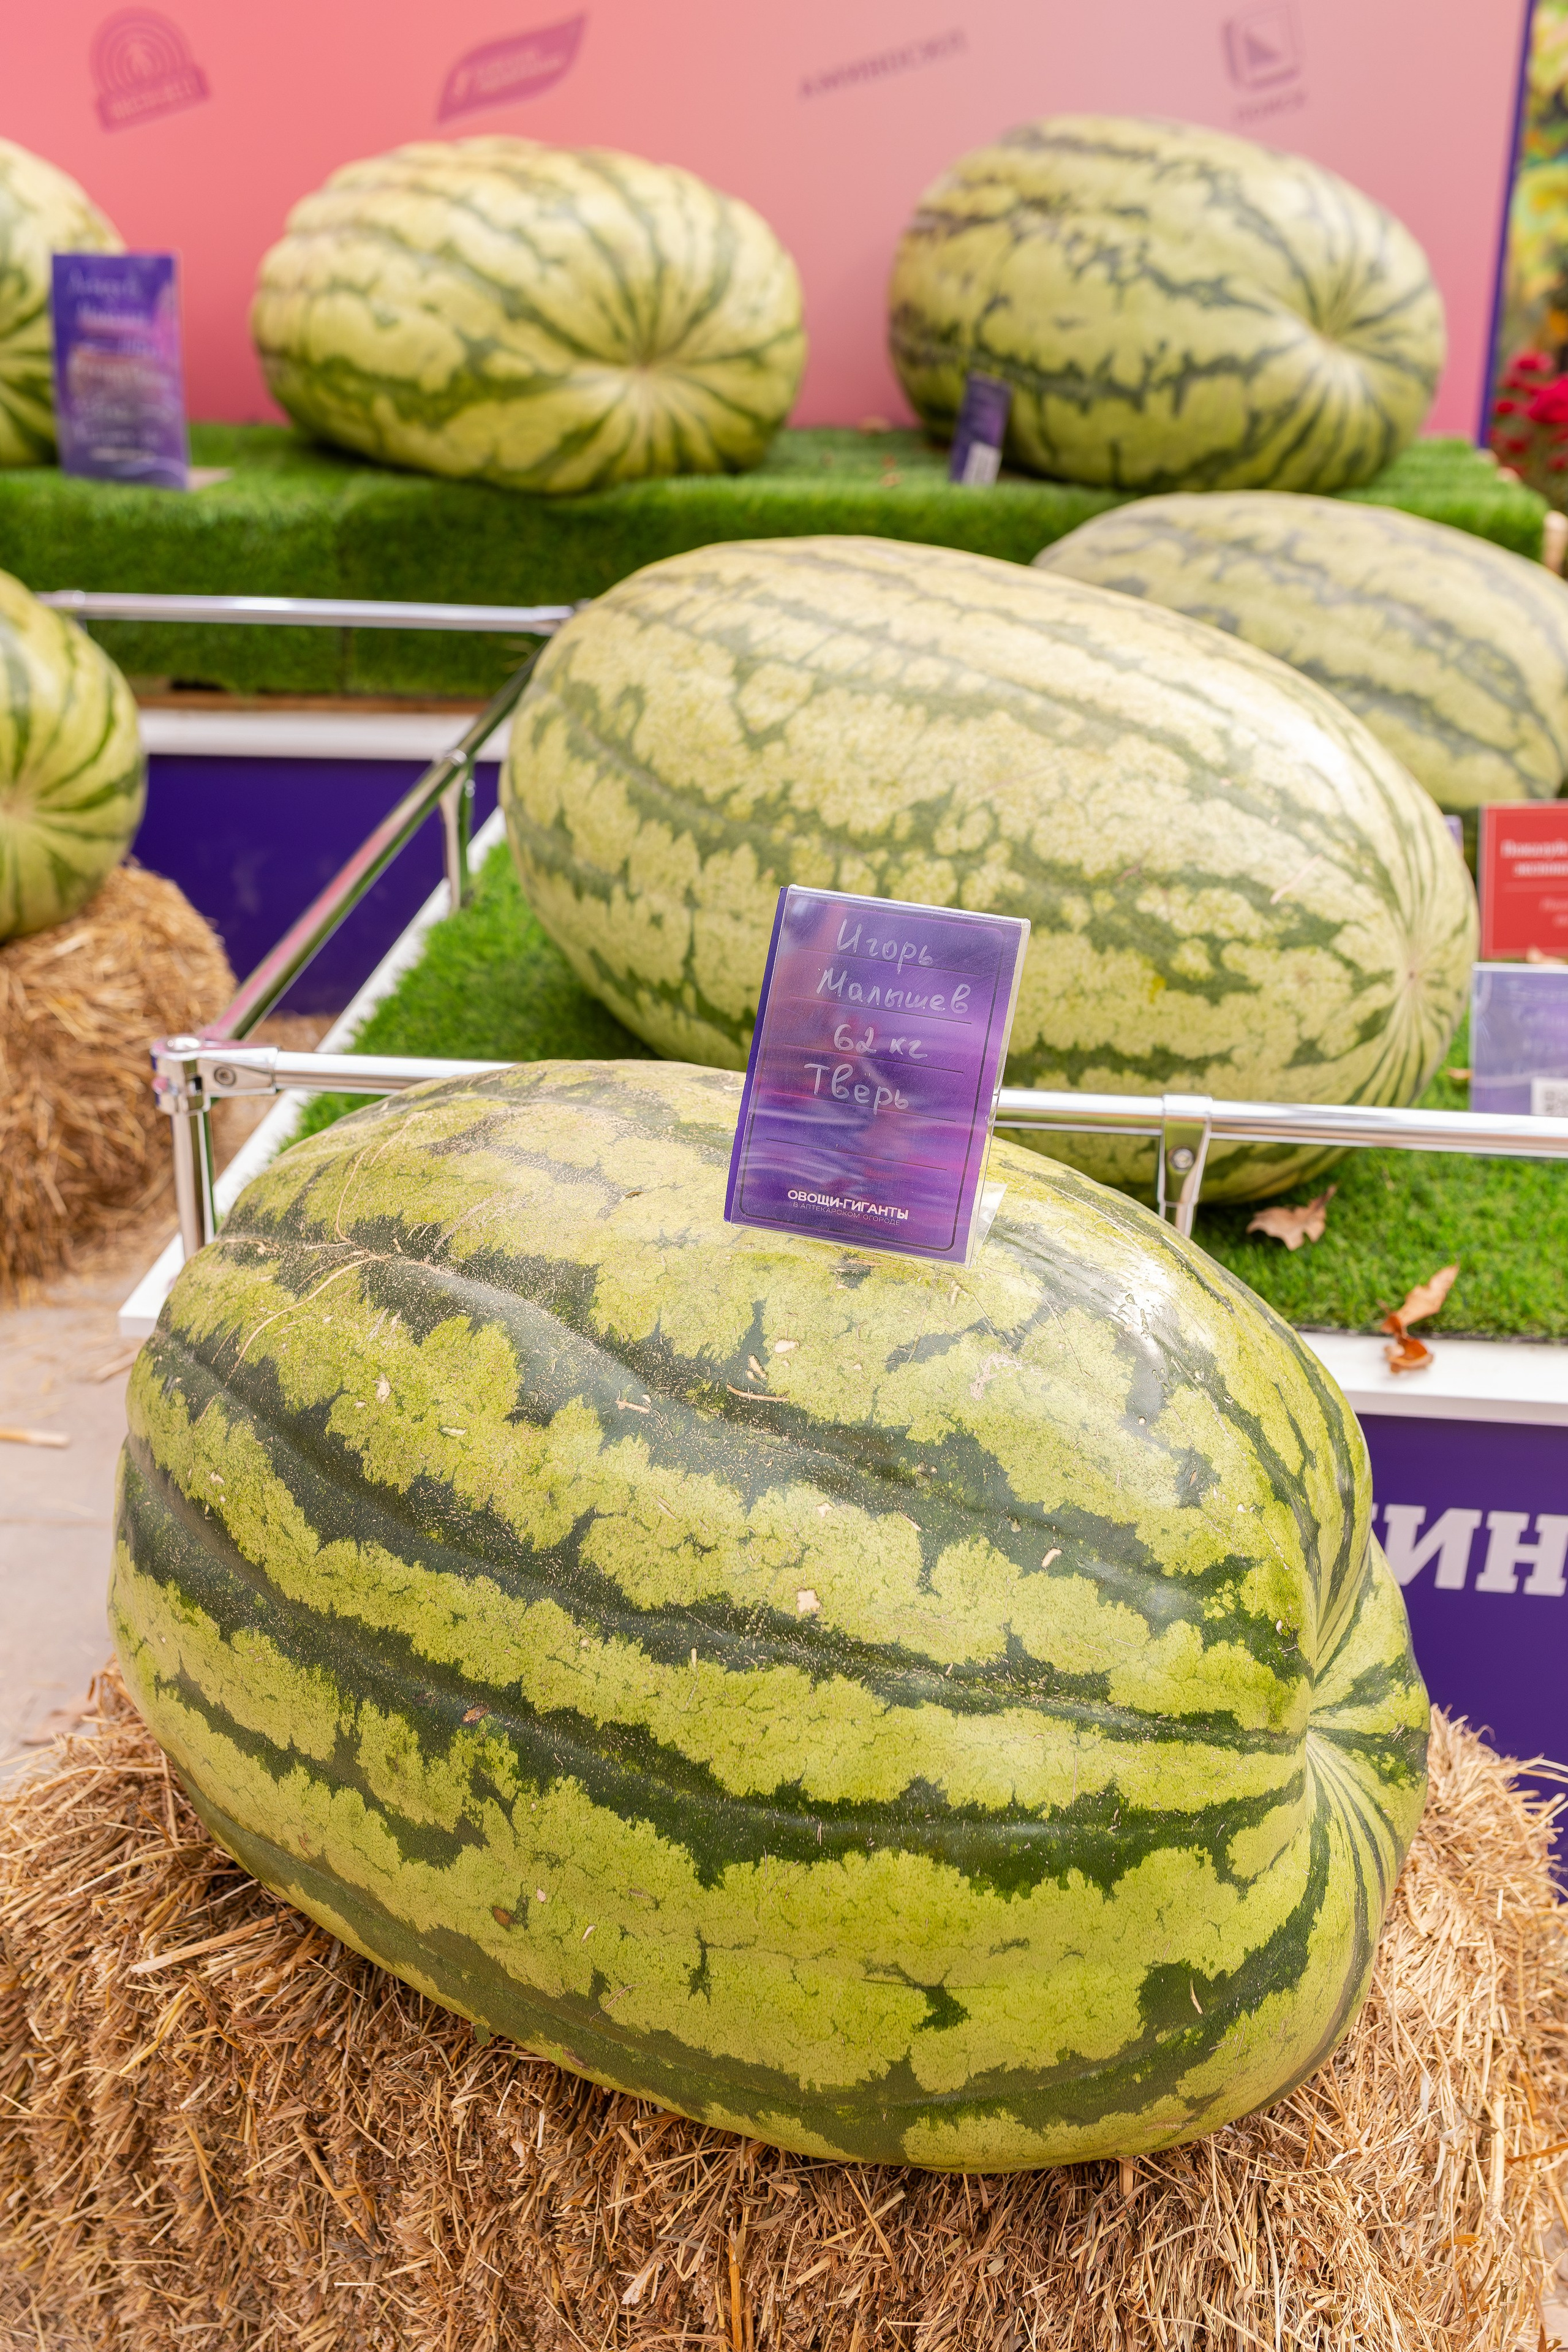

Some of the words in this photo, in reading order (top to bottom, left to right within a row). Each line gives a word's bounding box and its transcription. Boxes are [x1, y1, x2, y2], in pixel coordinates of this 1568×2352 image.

[837, 918, 933, 974] Игорь
[816, 967, 971, 1014] Малышев
[833, 1023, 877, 1054] 62
[889, 1036, 928, 1059] кг
[804, 1063, 910, 1116] Тверь
[787, 1189, 910, 1220] ОВОЩИ-ГИГАНТЫ
[862, 1213, 902, 1226] ОГОРОДЕ
[1372, 1502, 1568, 1597] ИН
